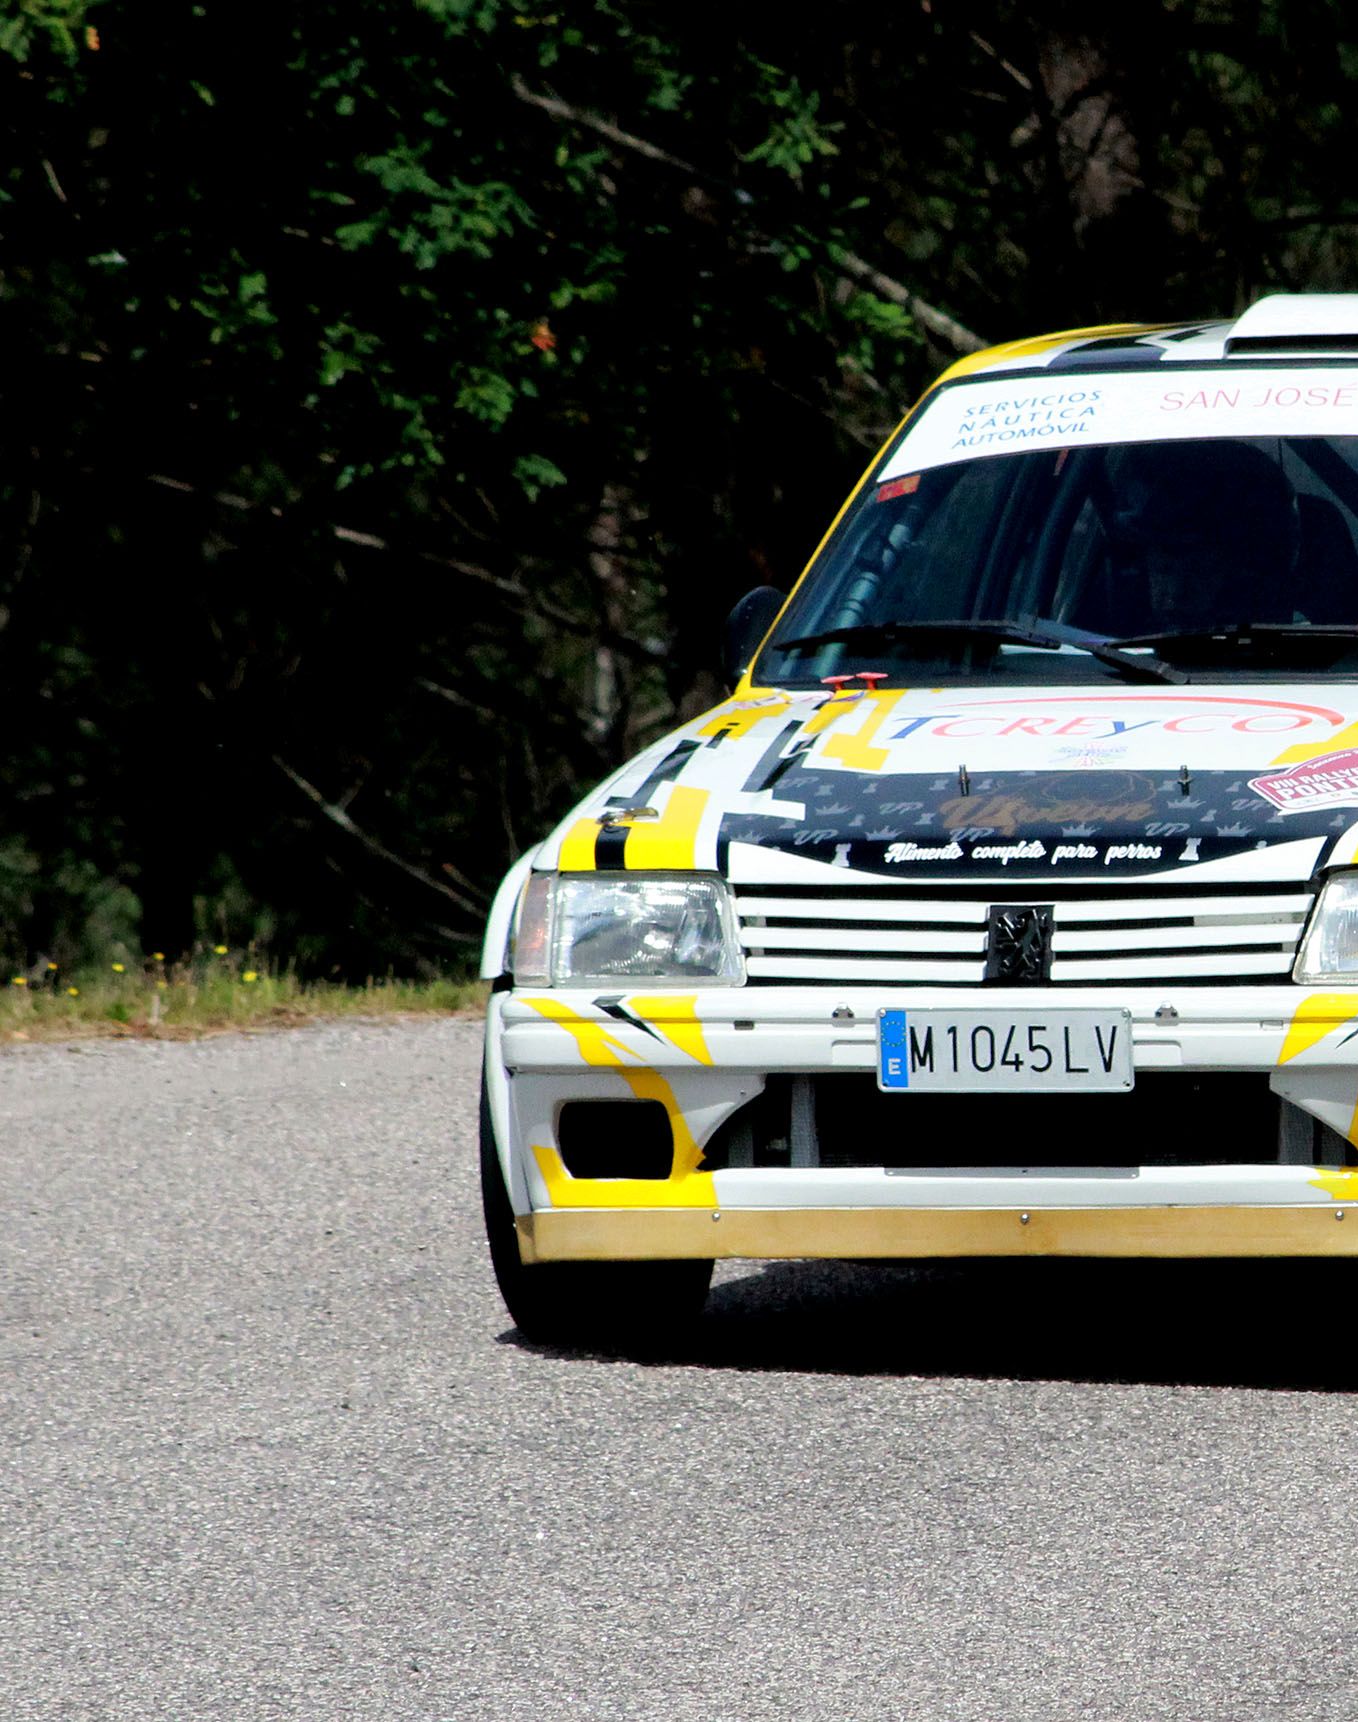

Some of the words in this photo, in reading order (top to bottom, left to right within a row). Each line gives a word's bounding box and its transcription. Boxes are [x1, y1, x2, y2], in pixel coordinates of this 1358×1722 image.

[963, 390, 1102, 418] SERVICIOS
[1160, 388, 1240, 411] SAN
[1253, 382, 1358, 407] JOSÉ
[951, 421, 1090, 449] AUTOMÓVIL
[1267, 778, 1297, 790] VIII
[884, 841, 964, 864] Alimento
[971, 840, 1047, 866] completo
[1050, 843, 1098, 866] para
[1103, 844, 1163, 866] perros
[909, 1025, 1118, 1074] M1045LV
[887, 1058, 902, 1075] E
